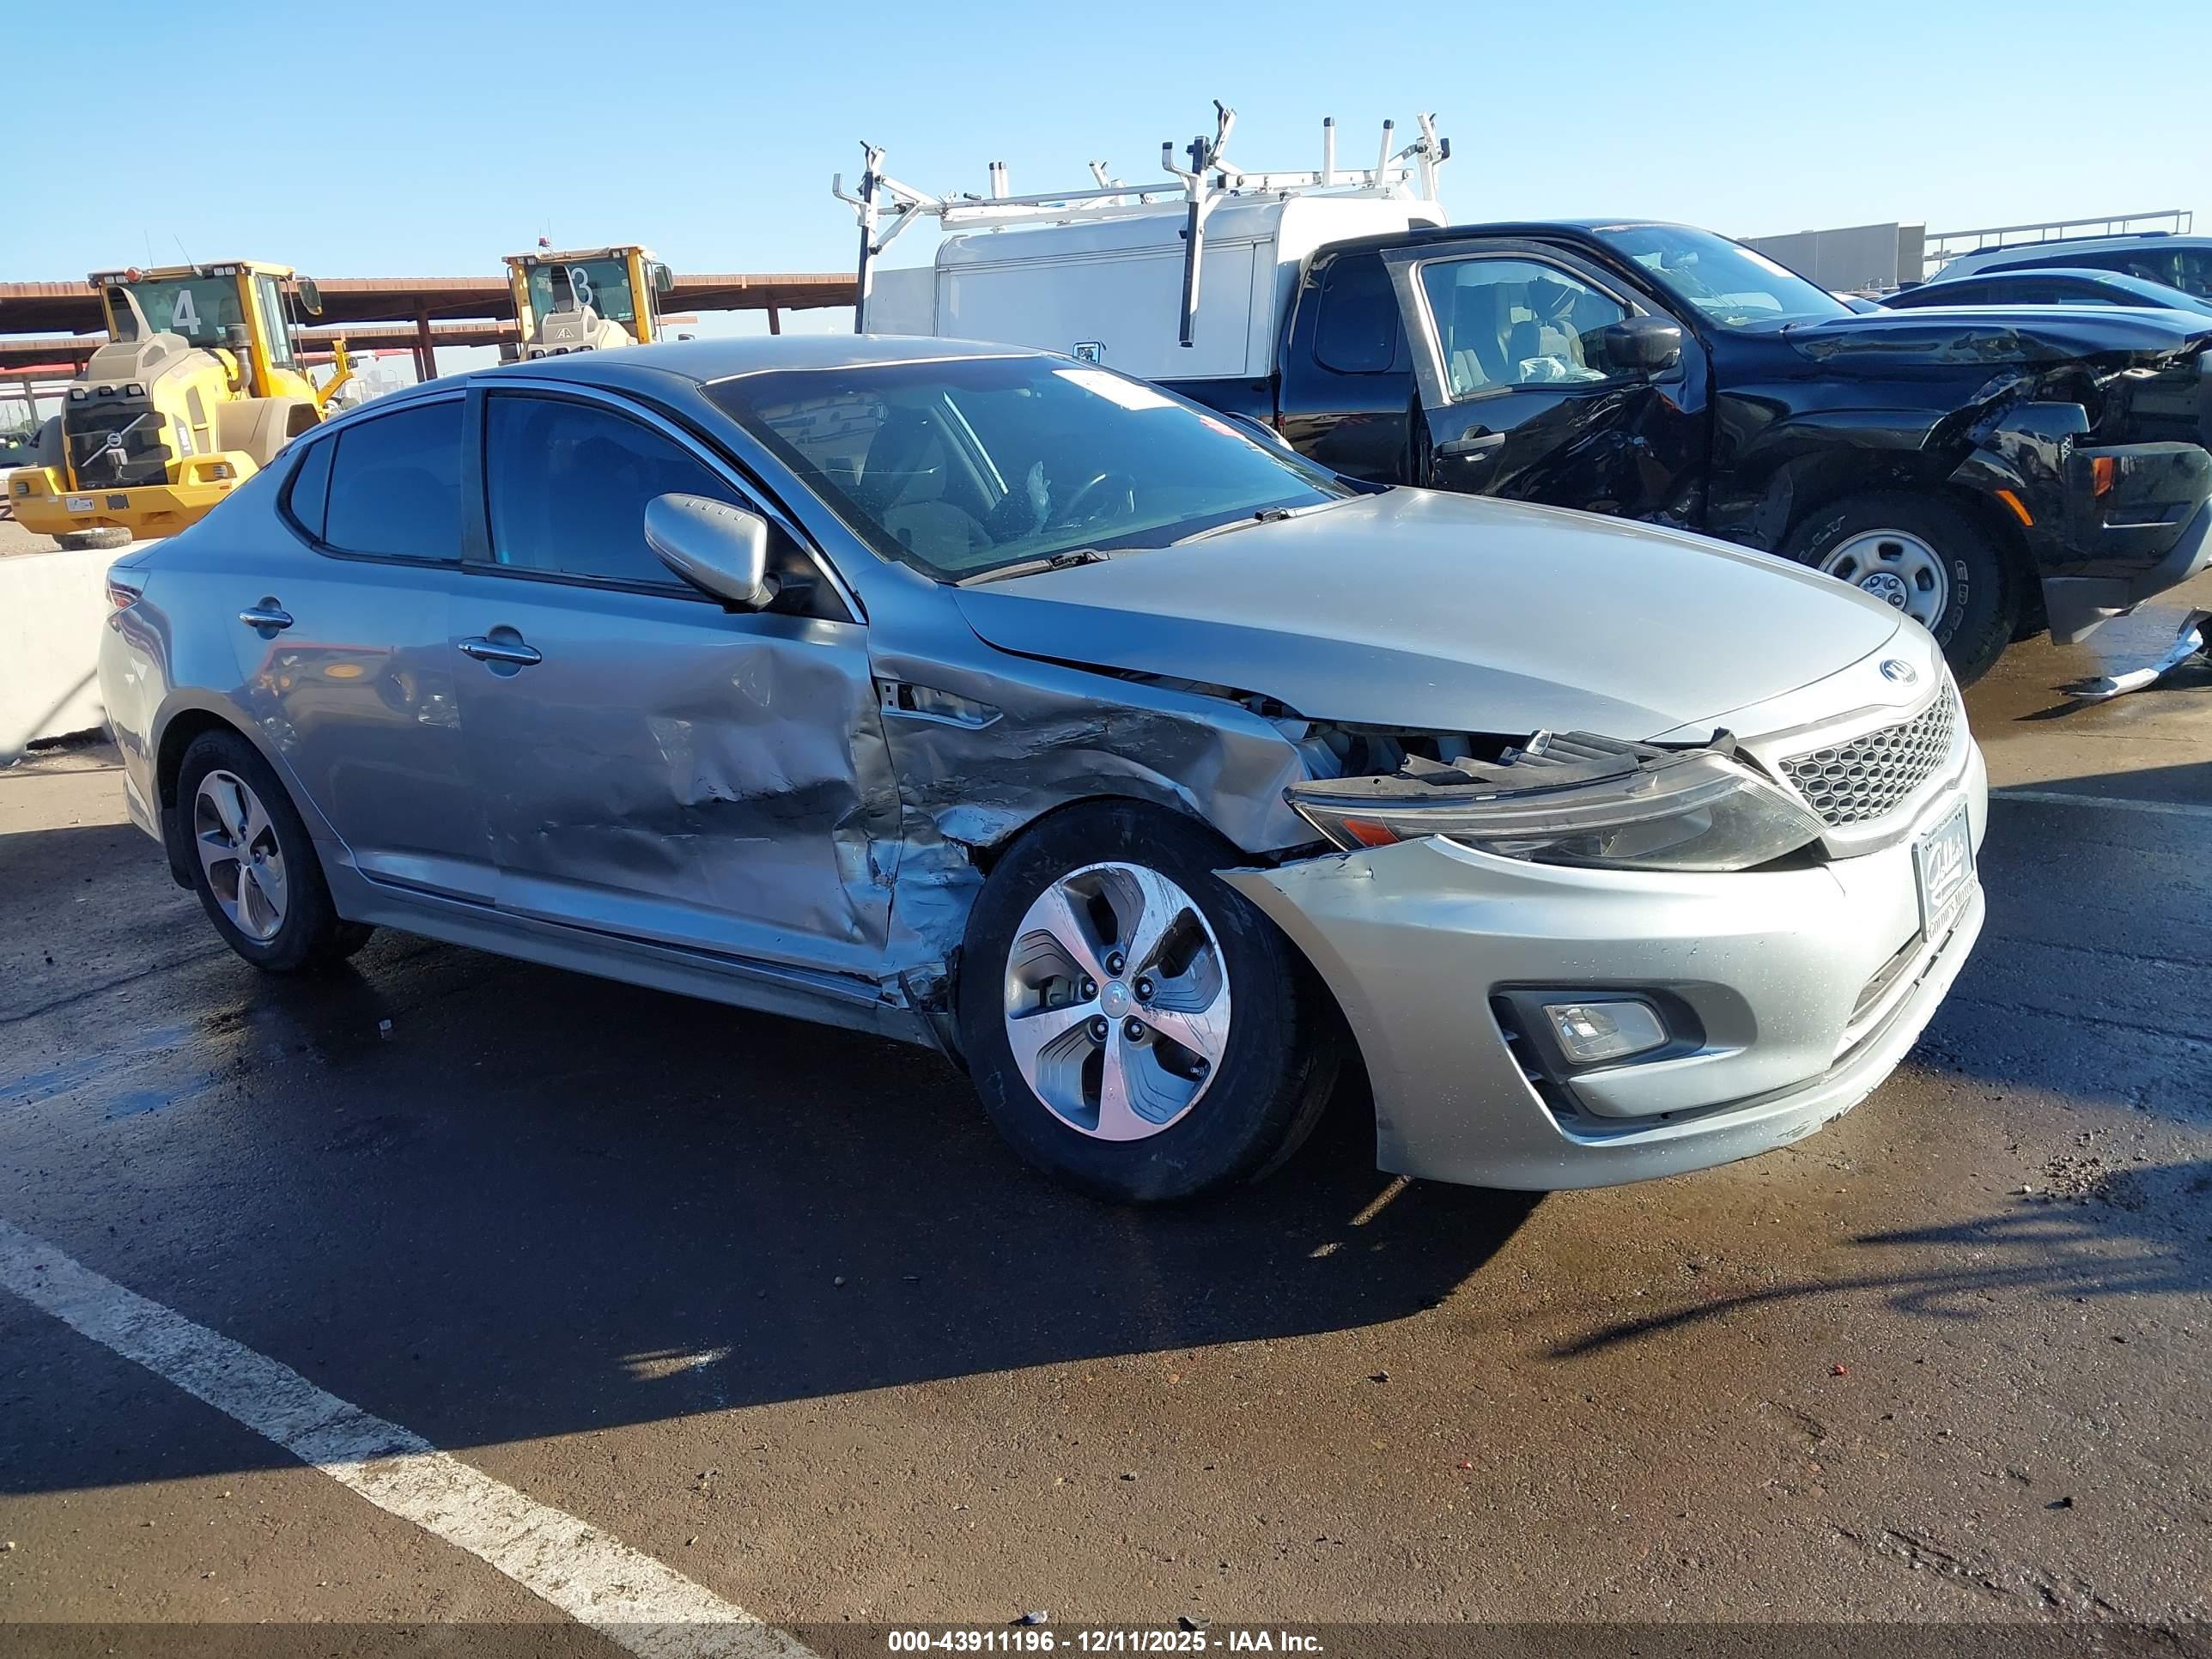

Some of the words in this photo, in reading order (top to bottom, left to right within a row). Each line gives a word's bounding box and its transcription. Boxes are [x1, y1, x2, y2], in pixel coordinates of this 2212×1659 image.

[571, 267, 593, 306] 3
[173, 289, 201, 335] 4
[1929, 901, 1955, 939] GOLDIE'S
[1954, 874, 1978, 910] MOTORS
